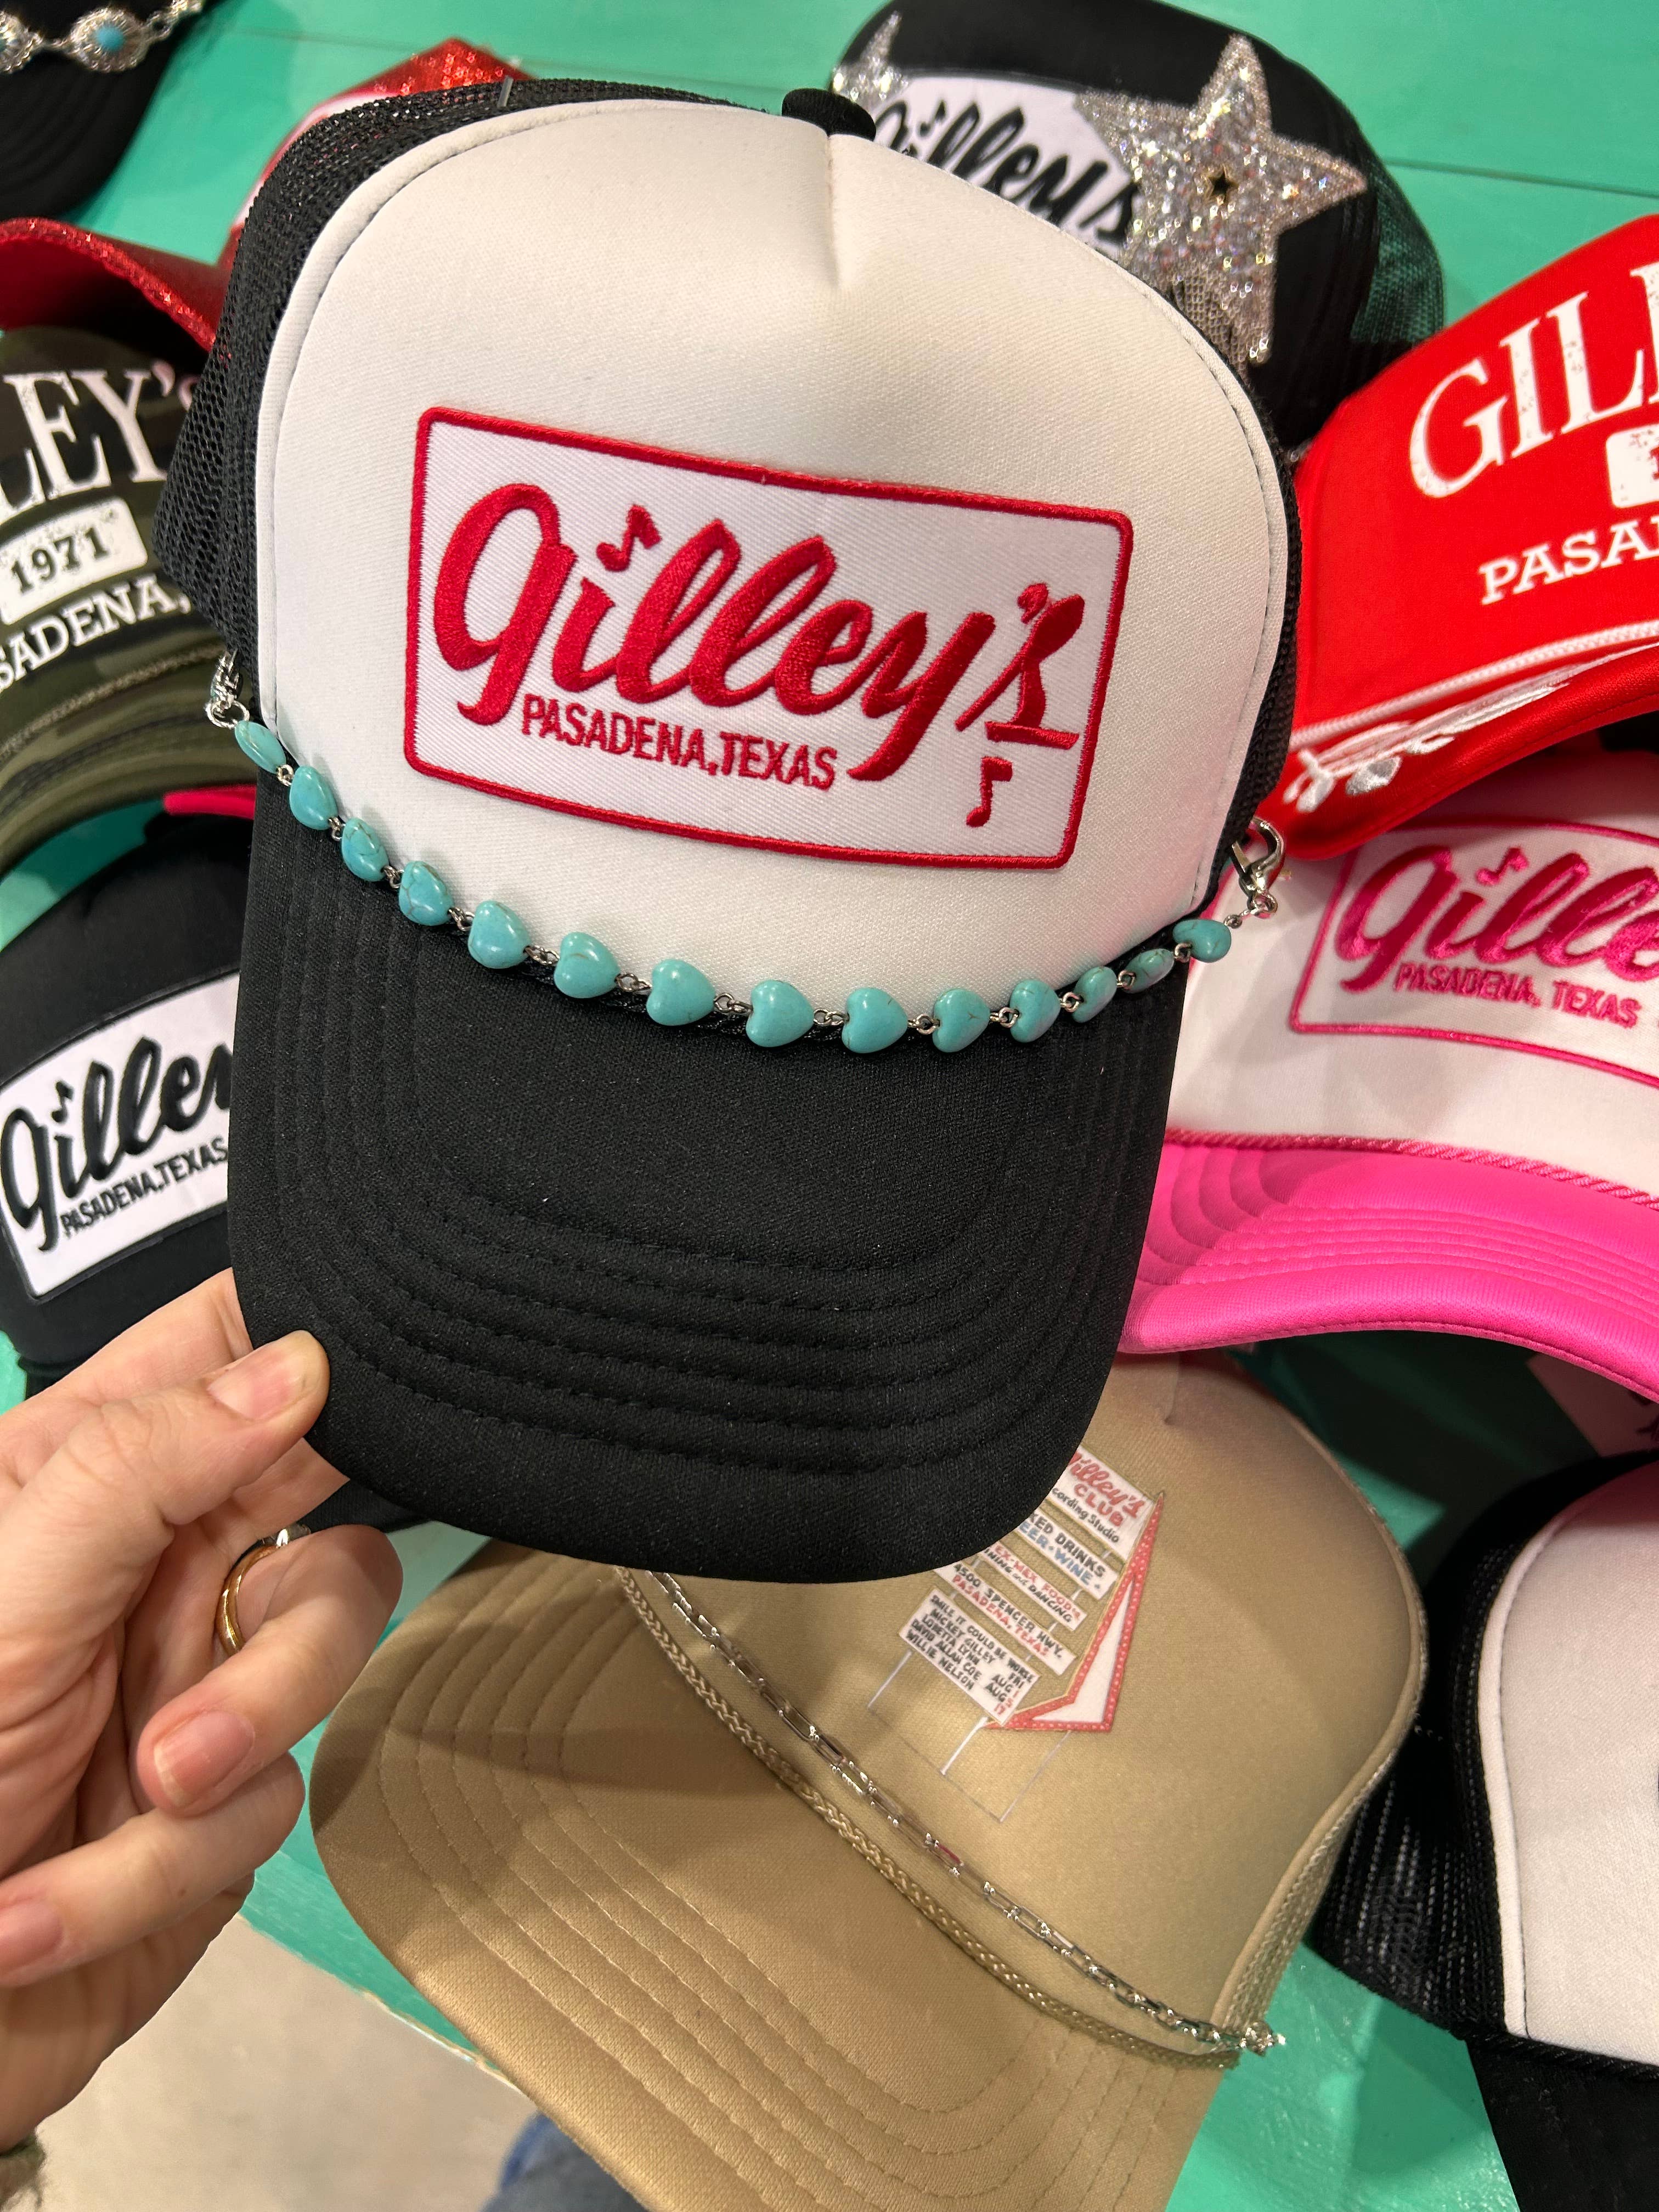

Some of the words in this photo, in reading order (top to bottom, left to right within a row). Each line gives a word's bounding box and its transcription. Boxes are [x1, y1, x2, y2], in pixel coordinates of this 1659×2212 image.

[11, 525, 114, 595] 1971
[1479, 515, 1659, 605] PASA
[1394, 961, 1541, 1009] PASADENA,
[1552, 980, 1641, 1028] TEXAS
[1052, 1487, 1088, 1520] cording
[1087, 1514, 1119, 1543] Studio
[1074, 1483, 1124, 1526] CLUB
[1020, 1520, 1048, 1548] EER
[1055, 1533, 1106, 1578] DRINKS
[953, 1564, 981, 1587] 4500
[984, 1588, 1036, 1633] SPENCER
[1028, 1584, 1072, 1622] DANCING
[929, 1609, 966, 1638] MICKEY
[963, 1638, 996, 1664] GILLEY
[956, 1616, 966, 1625] IT
[967, 1626, 994, 1650] COULD
[1015, 1624, 1049, 1656] TEXAS
[938, 1657, 974, 1690] NELSON
[963, 1662, 981, 1680] COE
[985, 1683, 1007, 1702] AUG
[991, 1674, 1013, 1693] AUG
